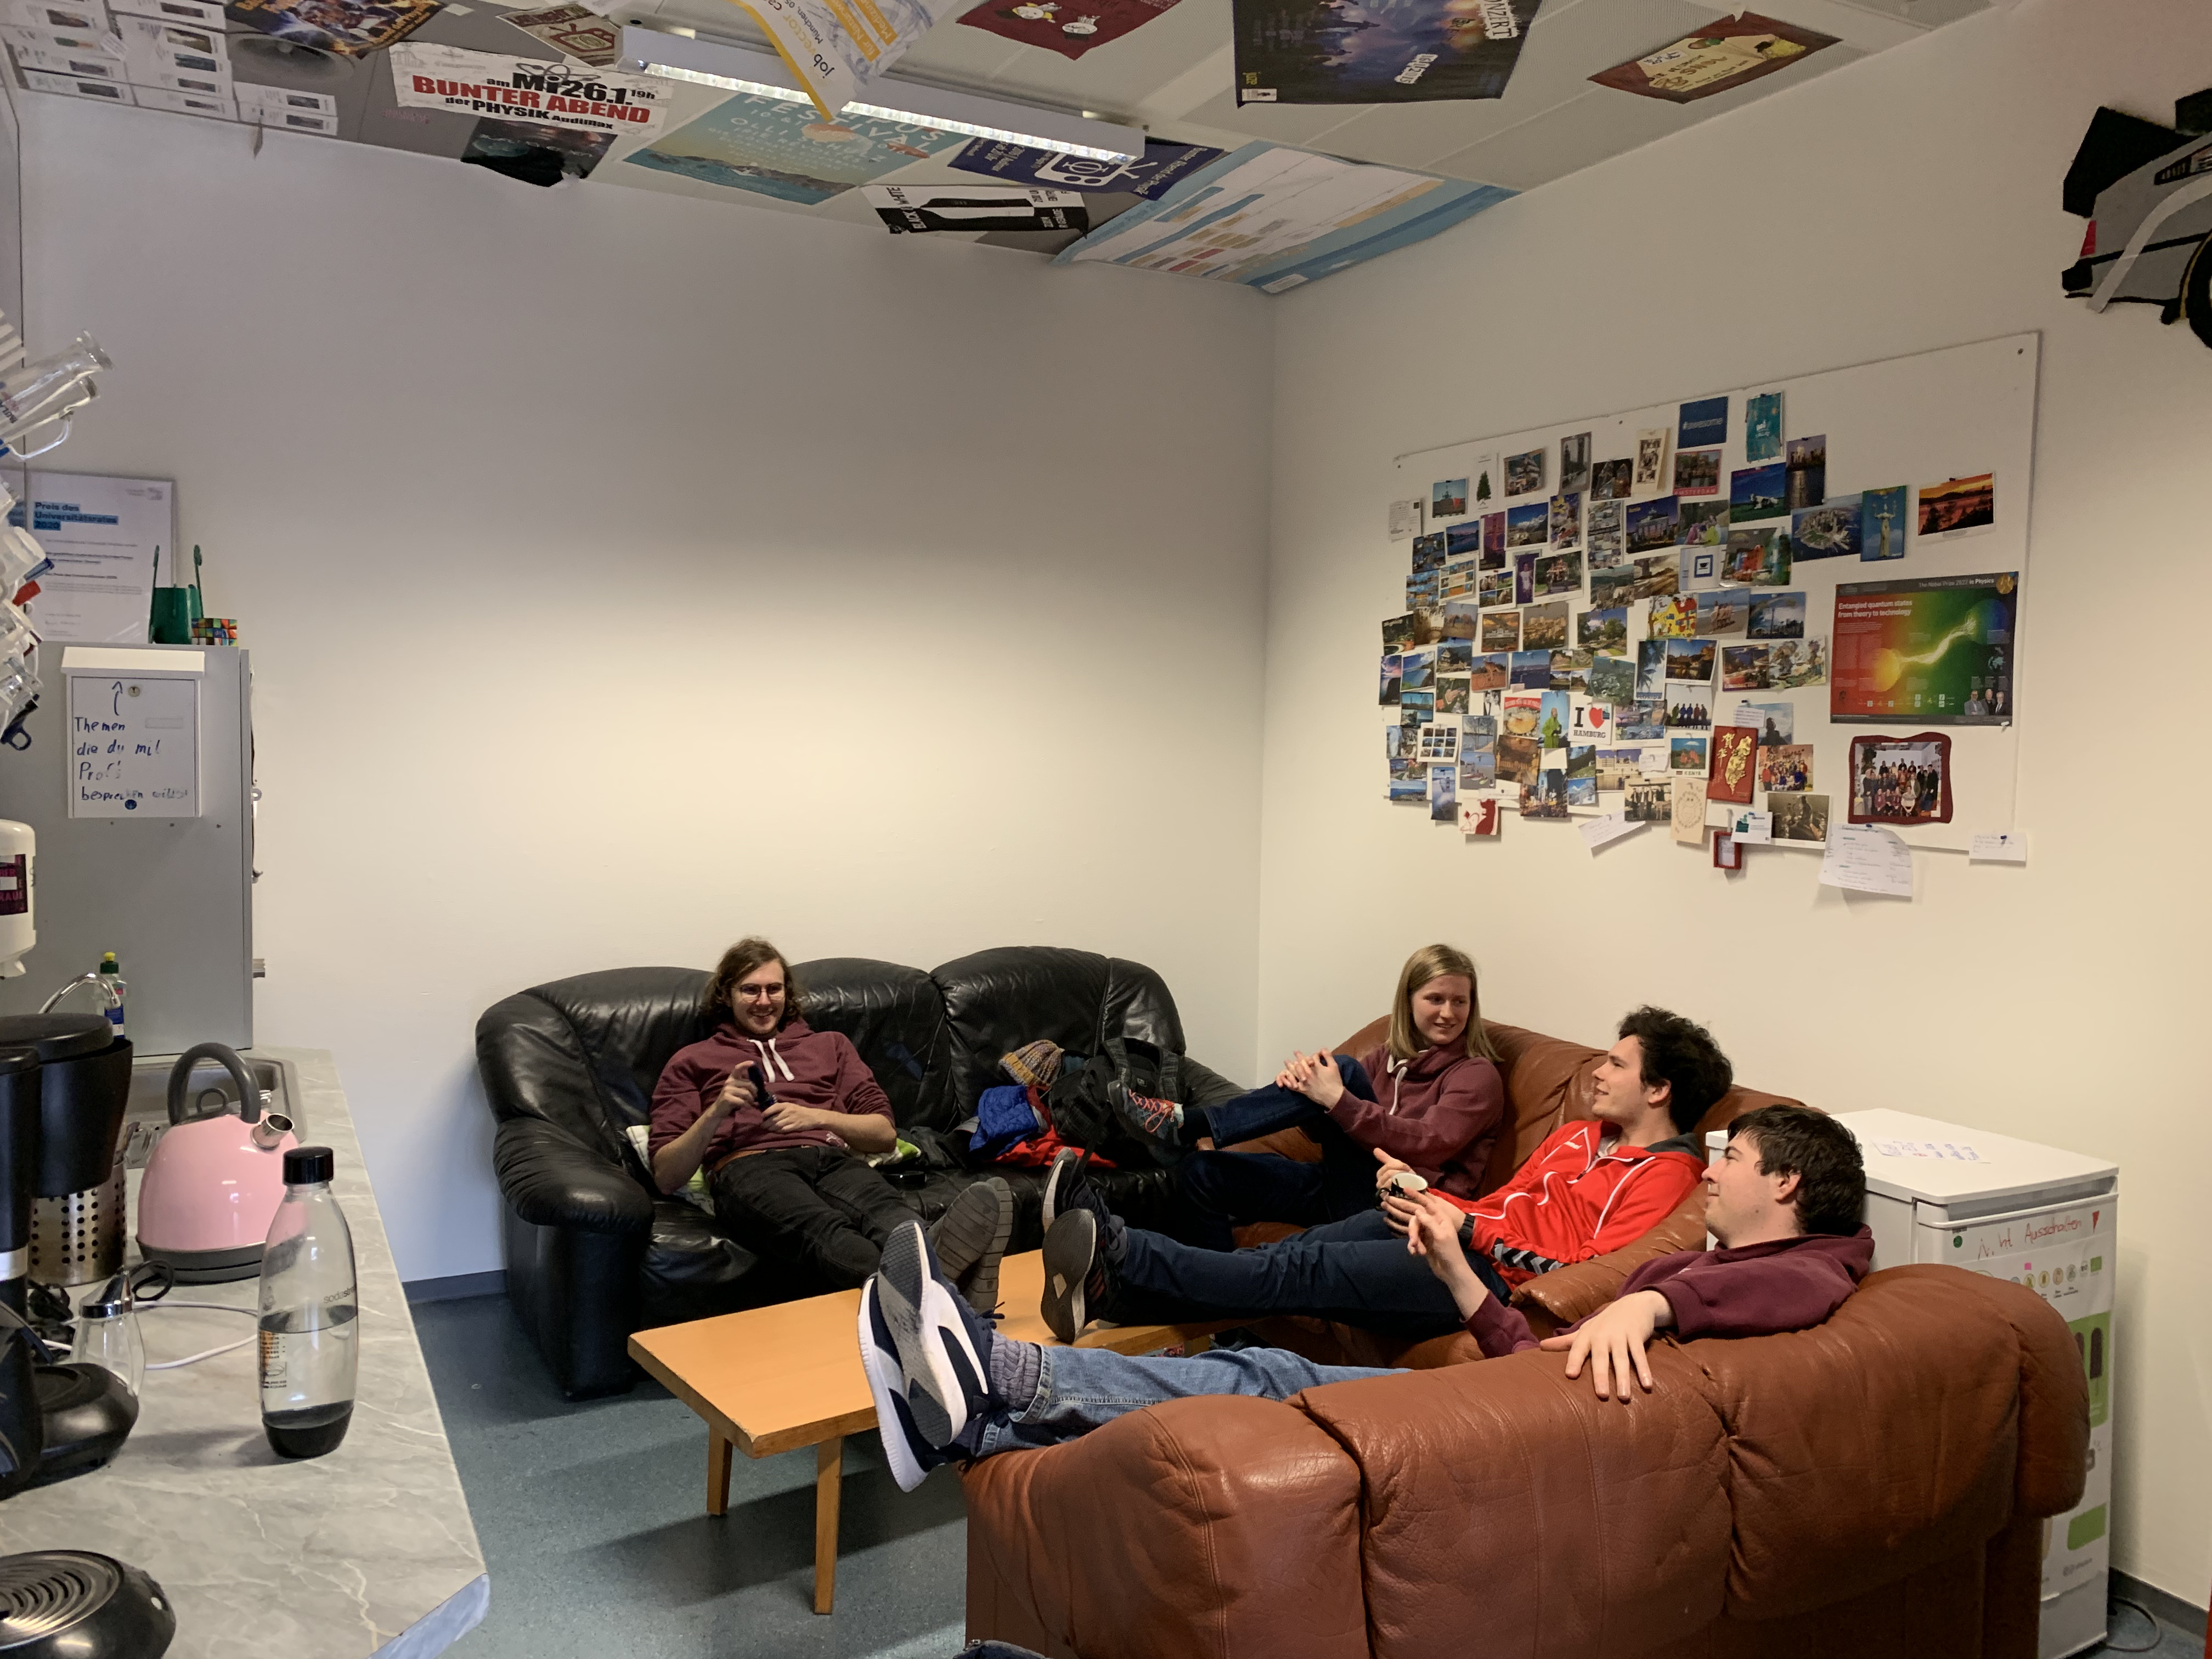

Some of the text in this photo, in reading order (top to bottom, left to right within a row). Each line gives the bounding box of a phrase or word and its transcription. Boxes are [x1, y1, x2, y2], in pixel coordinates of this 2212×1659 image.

[797, 6, 823, 44] München,
[783, 14, 834, 78] jobvector
[487, 78, 510, 88] am
[631, 89, 656, 100] 19h
[412, 75, 651, 124] BUNTER ABEND
[445, 97, 614, 130] der PHYSIK Audimax
[731, 117, 788, 136] OLLI
[744, 95, 933, 153] FESTIVAL
[886, 187, 908, 205] WHITE
[904, 208, 927, 229] BLACK
[1682, 417, 1723, 430] #awesome
[35, 502, 60, 511] Preis
[1838, 601, 1867, 610] Entangled
[1867, 601, 1894, 609] quantum
[1838, 610, 1853, 618] from
[1853, 610, 1872, 618] theory
[1880, 608, 1912, 617] technology
[75, 716, 126, 732] Themen
[1573, 707, 1585, 728] I
[1573, 730, 1606, 739] HAMBURG
[77, 743, 98, 756] die
[323, 1284, 356, 1305] sodastre
